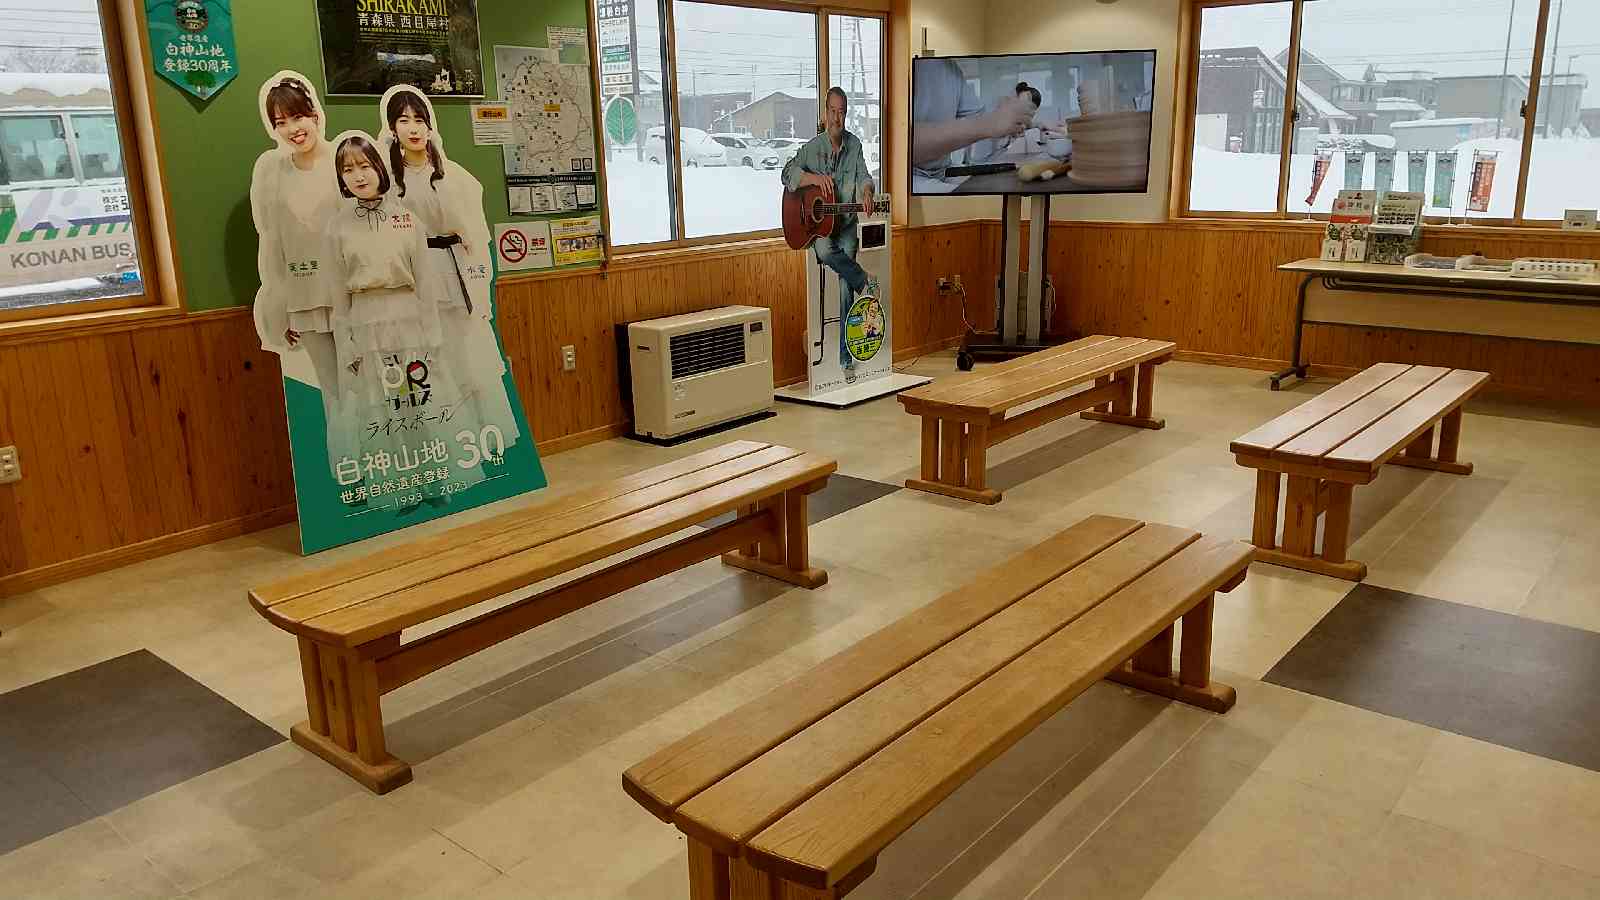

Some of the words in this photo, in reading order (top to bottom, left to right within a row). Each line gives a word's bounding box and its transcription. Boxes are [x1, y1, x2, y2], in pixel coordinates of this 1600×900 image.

[166, 42, 225, 56] 白神山地
[164, 57, 232, 73] 登録30周年
[10, 246, 87, 269] KONAN
[92, 242, 131, 260] BUS
[367, 408, 454, 440] ライスボール
[336, 437, 449, 485] 白神山地
[340, 467, 450, 504] 世界自然遺産登録
[393, 493, 424, 506] 1993
